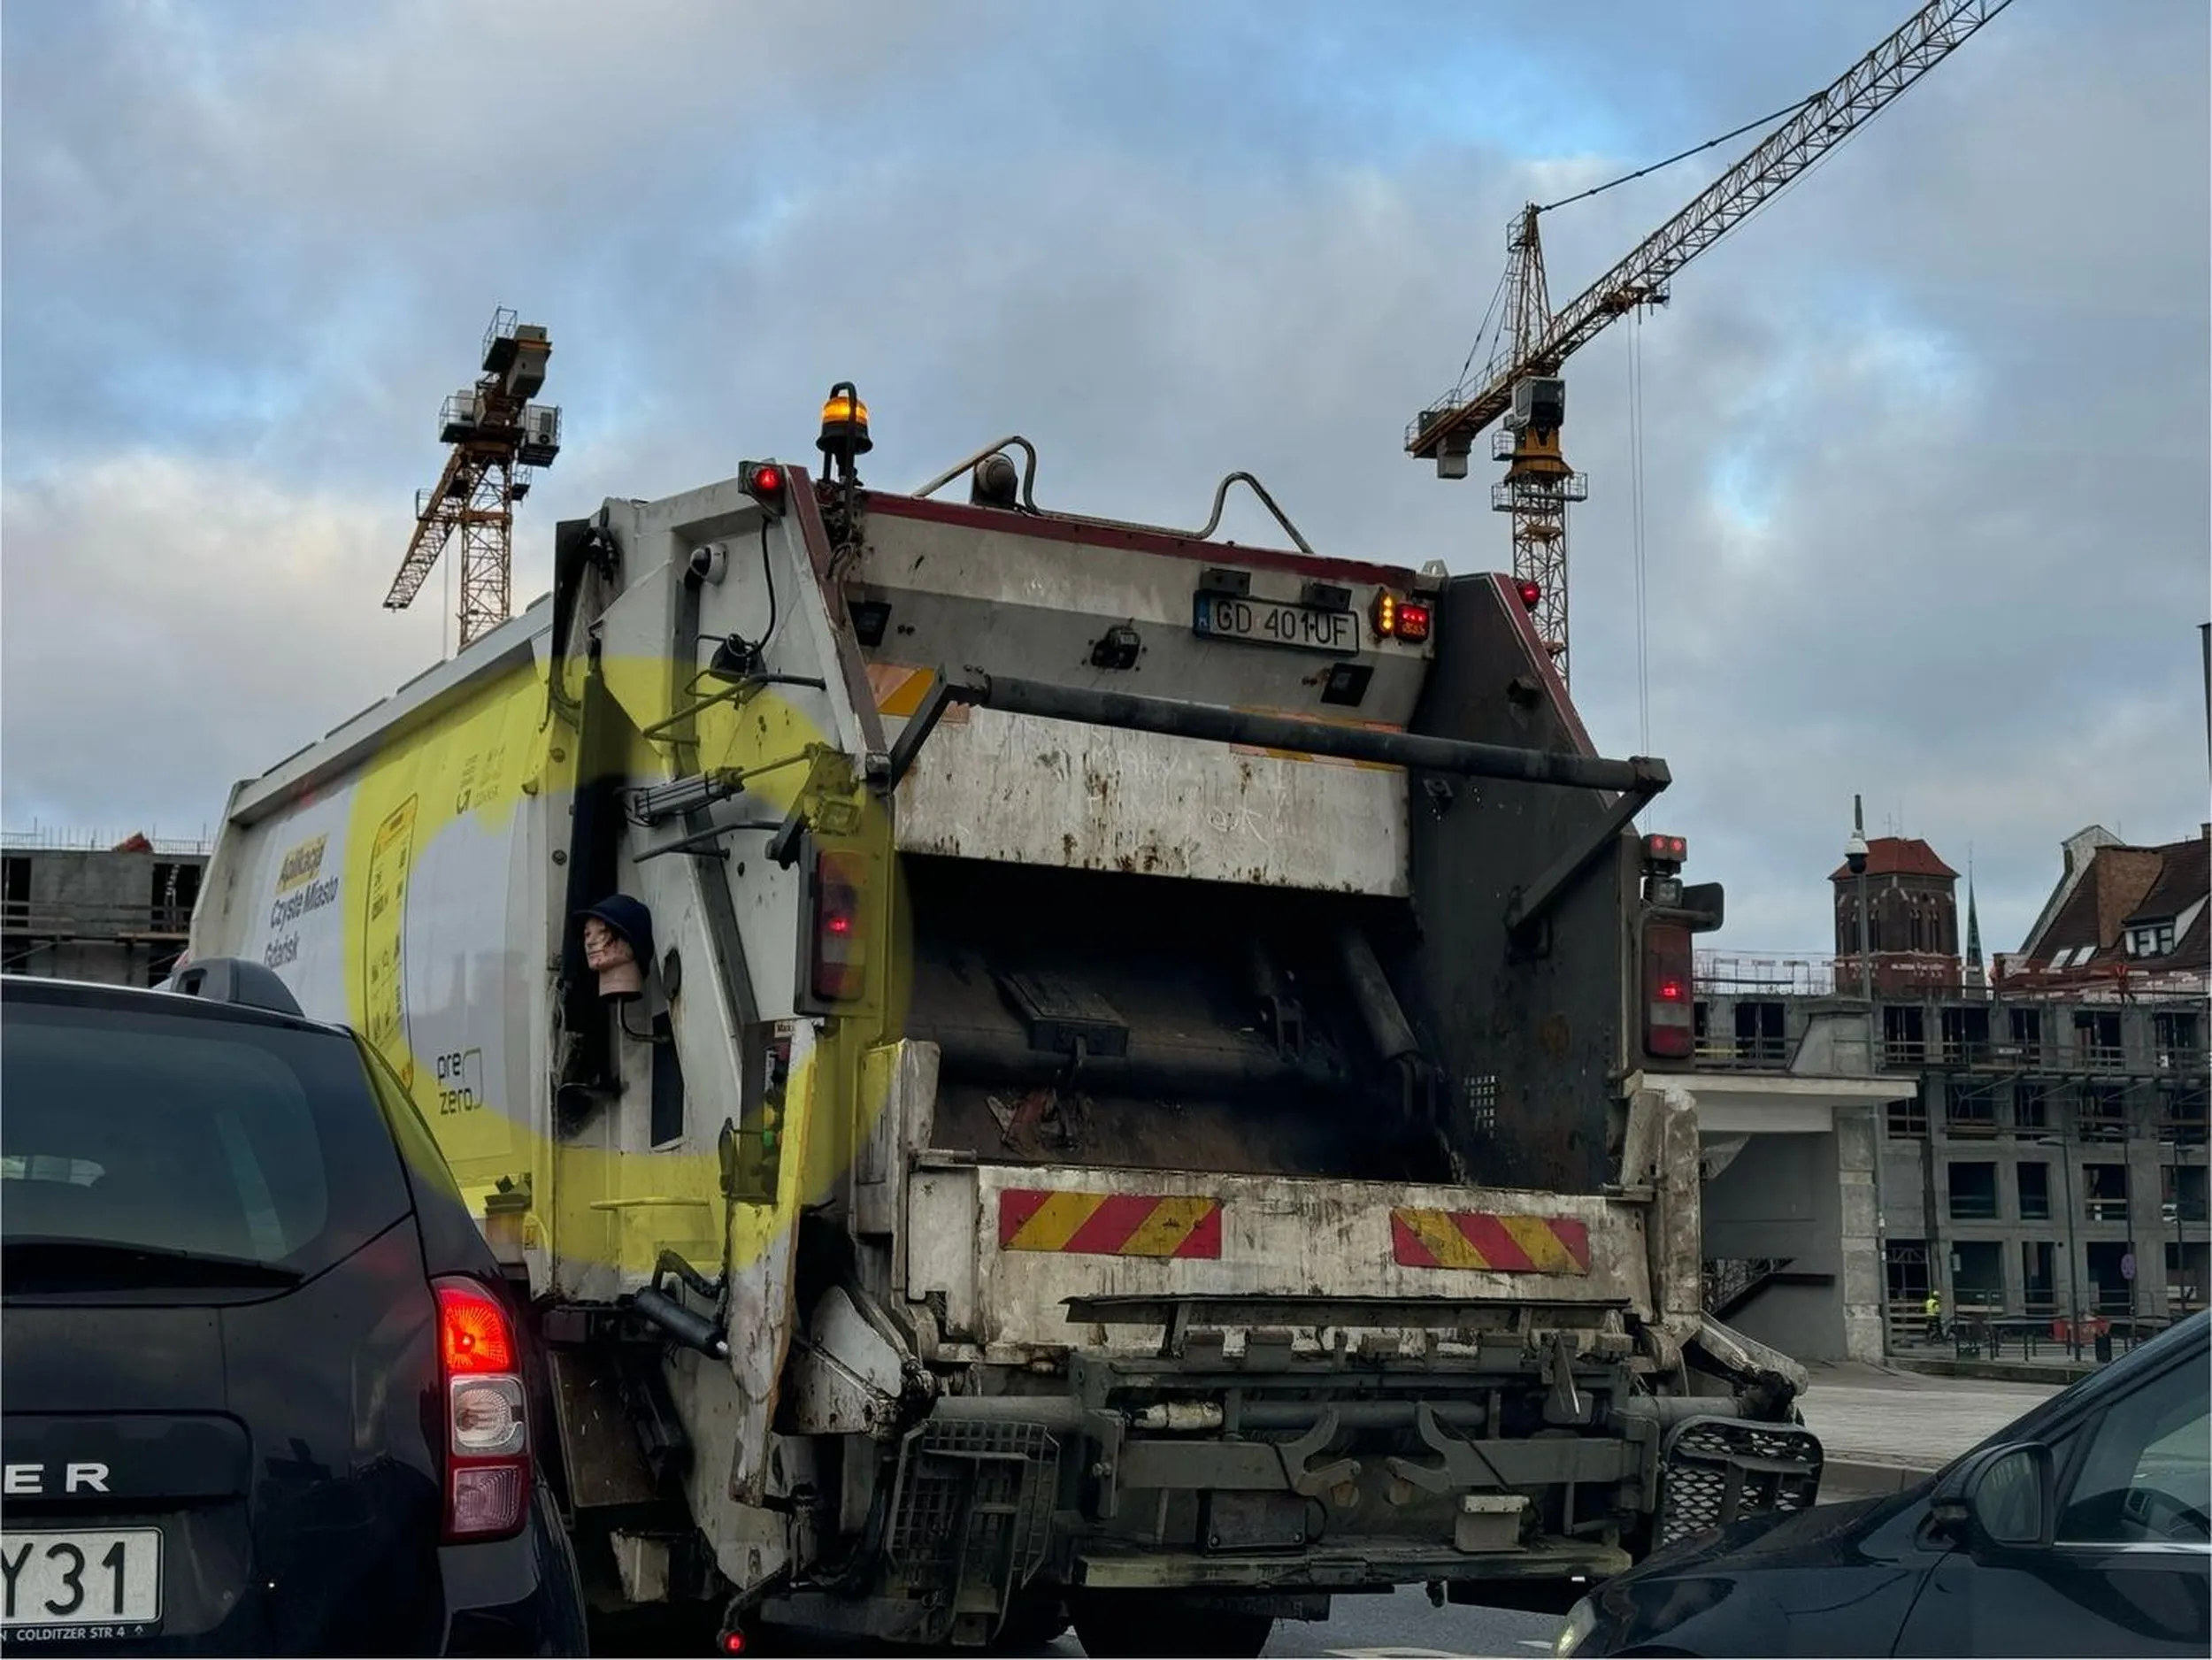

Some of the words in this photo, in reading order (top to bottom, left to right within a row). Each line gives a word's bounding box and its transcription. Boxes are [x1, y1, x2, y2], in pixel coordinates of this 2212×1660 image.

[1217, 600, 1252, 634] GD
[1263, 608, 1349, 646] 401UF
[270, 889, 303, 933] Czyste
[303, 875, 339, 913] Miasto
[437, 1052, 462, 1086] pre
[439, 1087, 472, 1115] zero
[2, 1541, 126, 1618] Y31
[16, 1628, 86, 1641] COLDITZER
[89, 1626, 112, 1638] STR
[116, 1625, 125, 1637] 4
